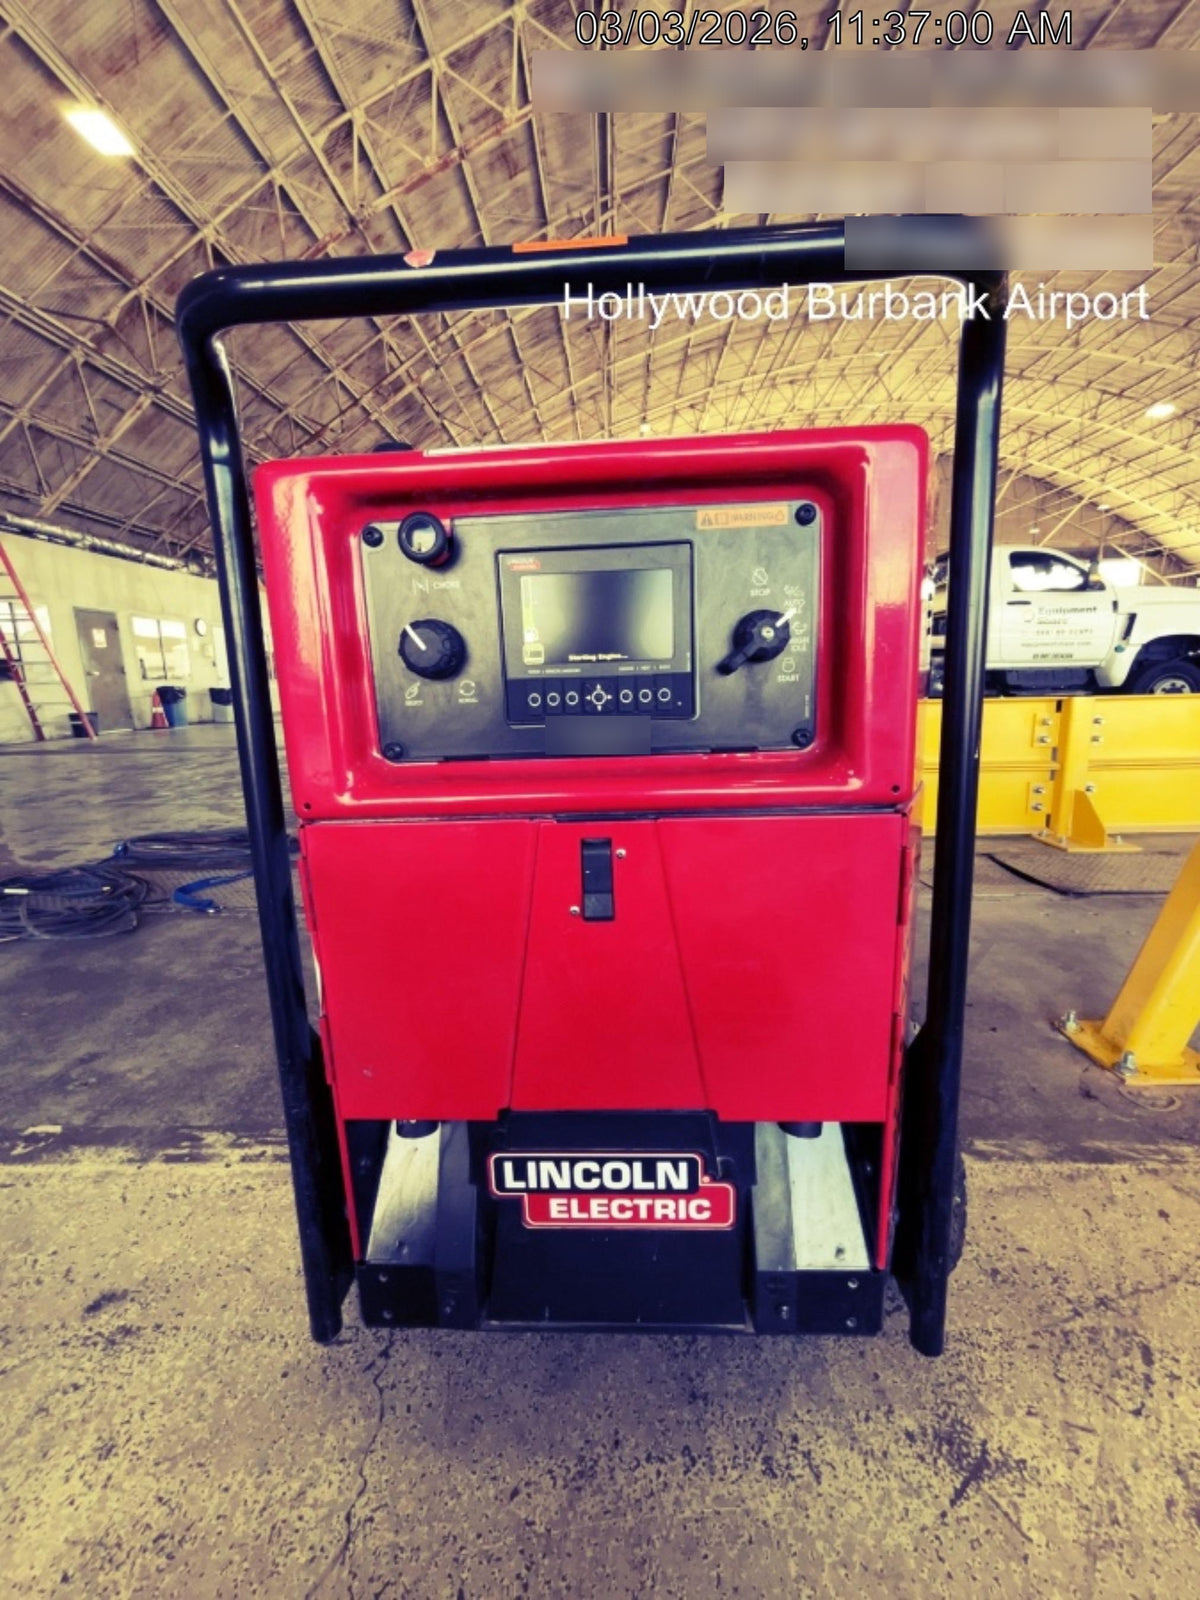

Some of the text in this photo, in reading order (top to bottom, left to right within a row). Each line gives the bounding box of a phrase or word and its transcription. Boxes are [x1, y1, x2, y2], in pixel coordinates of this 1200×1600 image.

[750, 588, 771, 597] STOP
[503, 1160, 689, 1191] LINCOLN
[549, 1198, 712, 1220] ELECTRIC
